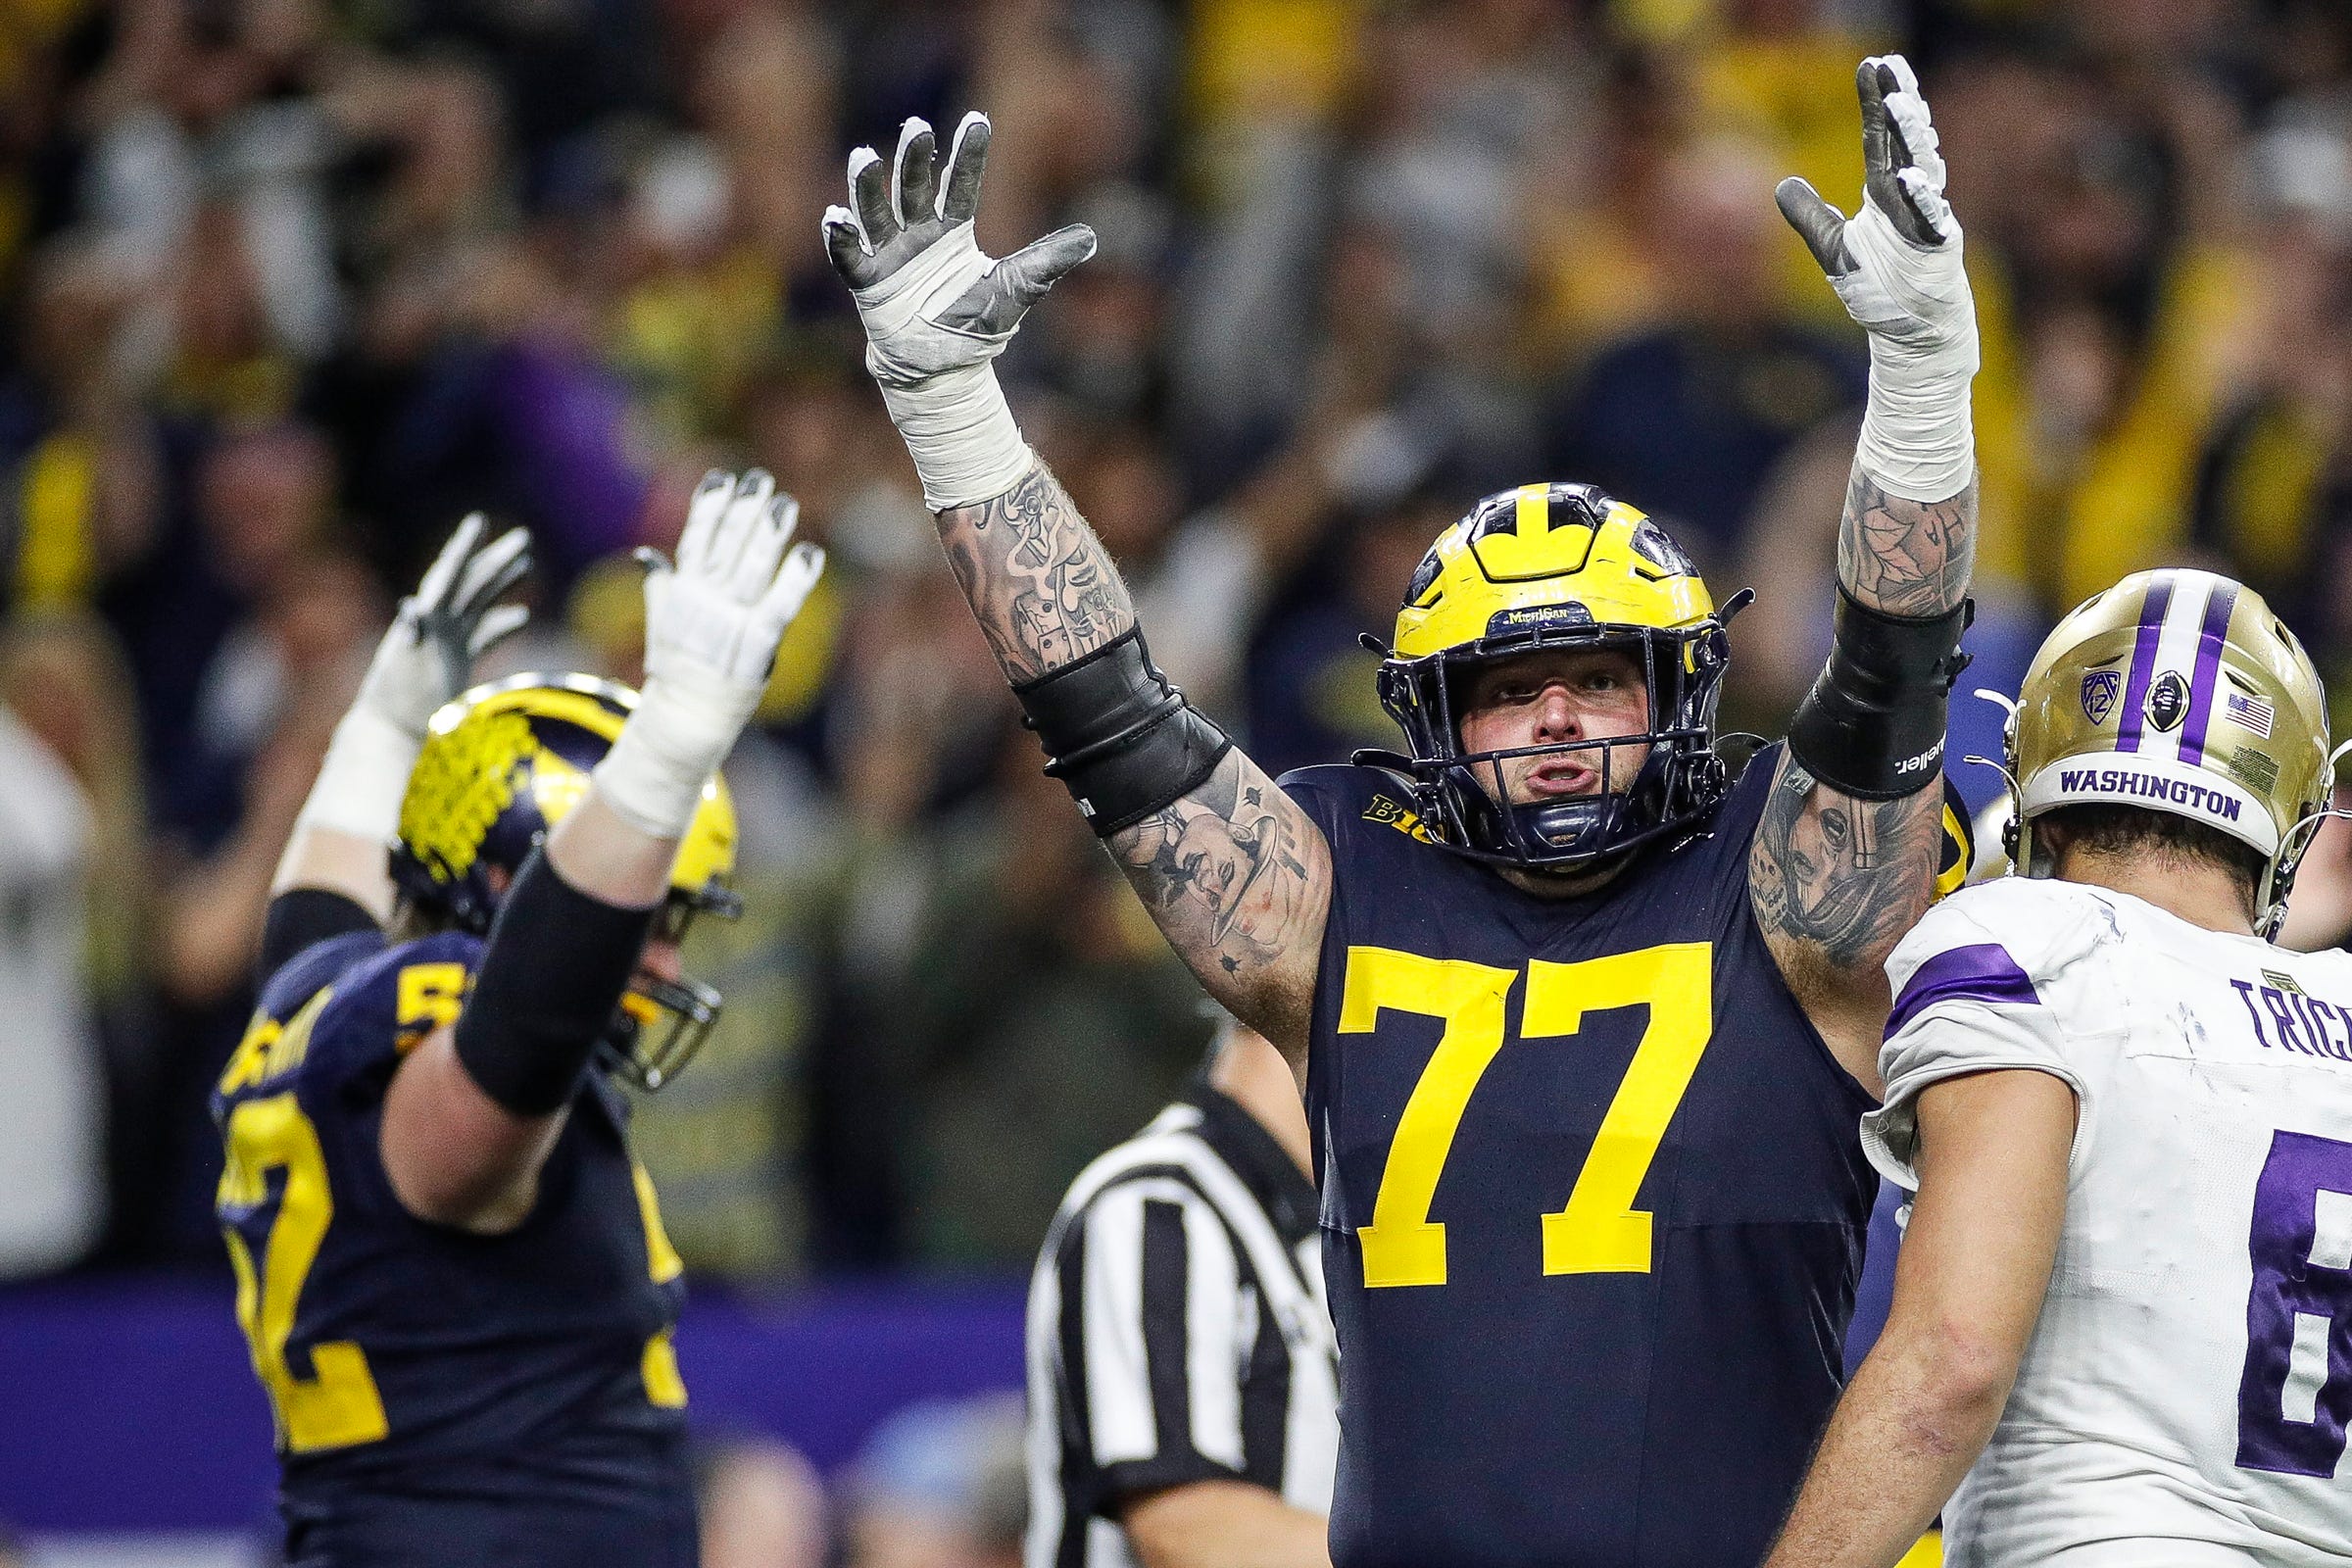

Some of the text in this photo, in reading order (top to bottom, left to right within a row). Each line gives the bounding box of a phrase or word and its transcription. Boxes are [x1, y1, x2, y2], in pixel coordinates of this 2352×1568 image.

[2089, 694, 2108, 713] 12
[2061, 770, 2241, 821] WASHINGTON
[1337, 941, 1713, 1289] 77
